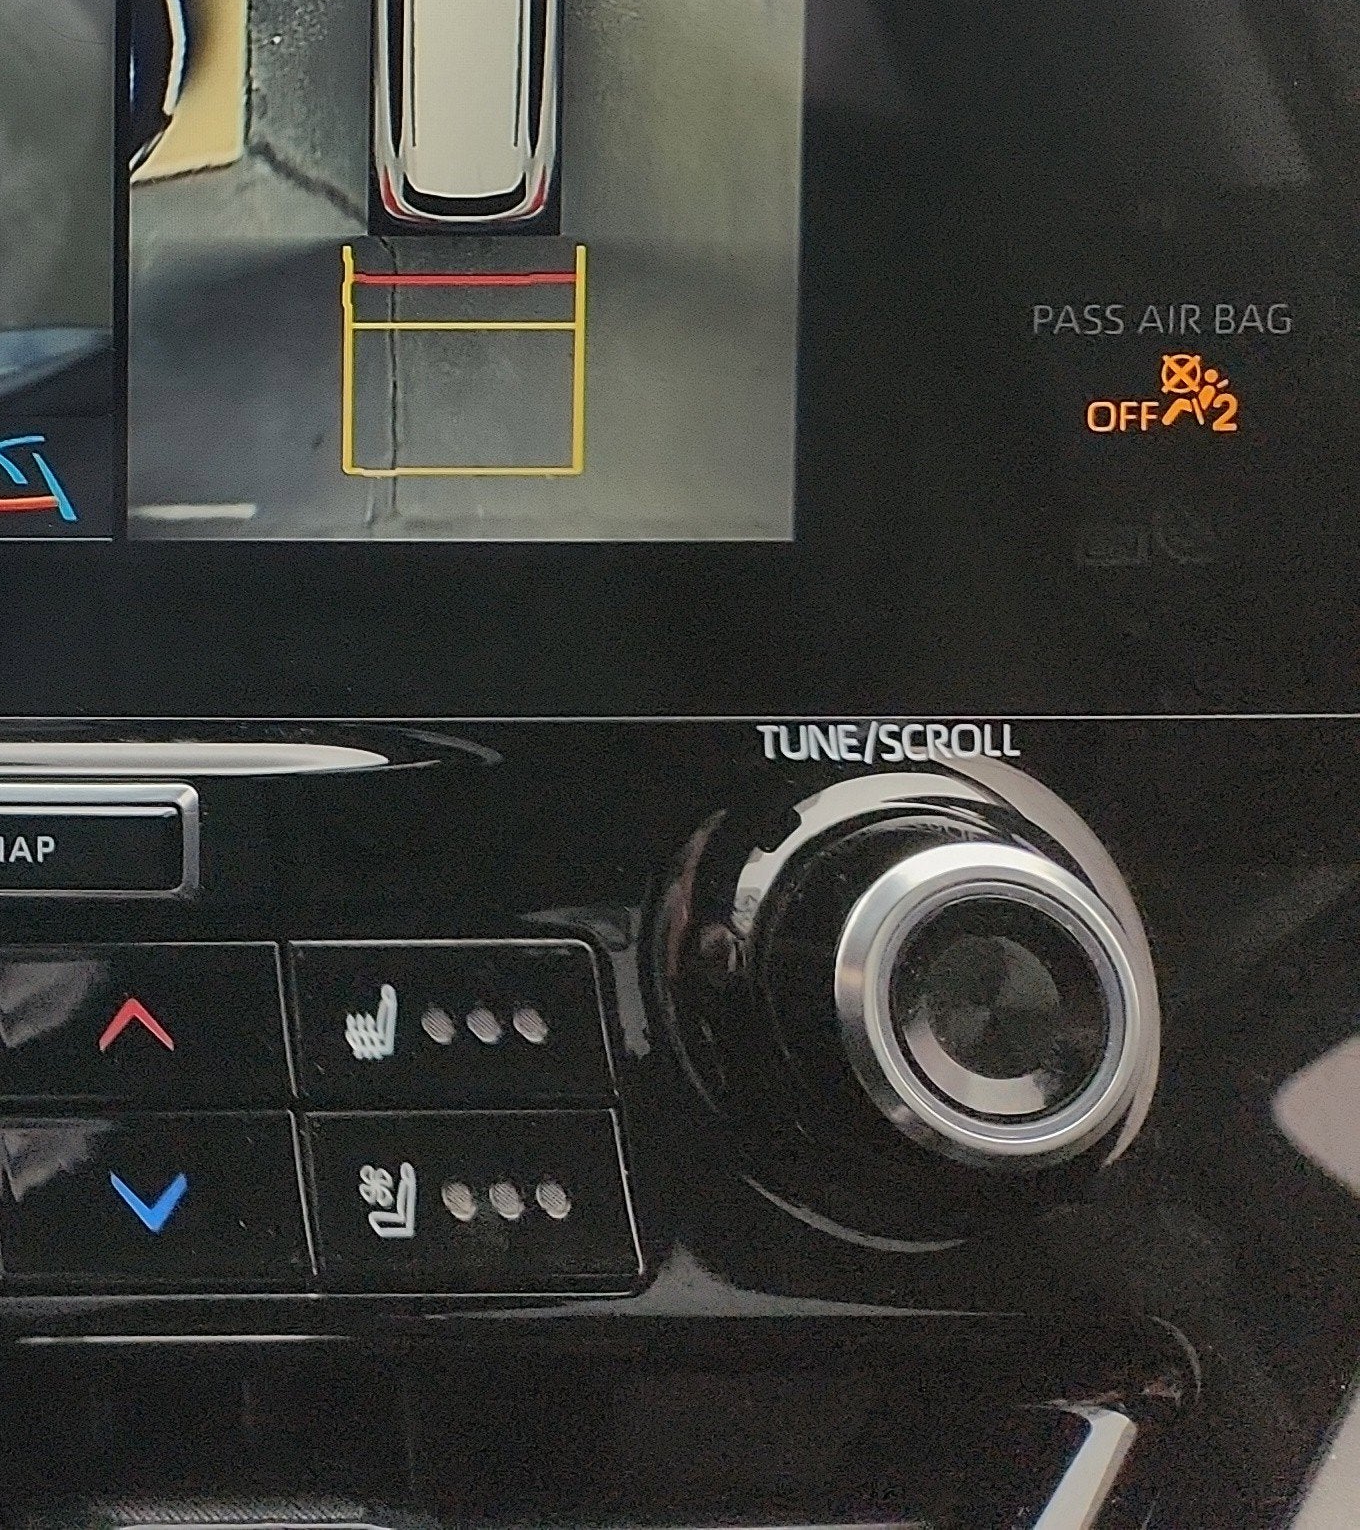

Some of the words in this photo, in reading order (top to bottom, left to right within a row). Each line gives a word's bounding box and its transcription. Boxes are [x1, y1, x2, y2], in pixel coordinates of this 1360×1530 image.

[1032, 304, 1125, 335] PASS
[1137, 303, 1202, 335] AIR
[1214, 303, 1293, 335] BAG
[1086, 400, 1160, 432] OFF
[756, 721, 1021, 765] TUNE/SCROLL
